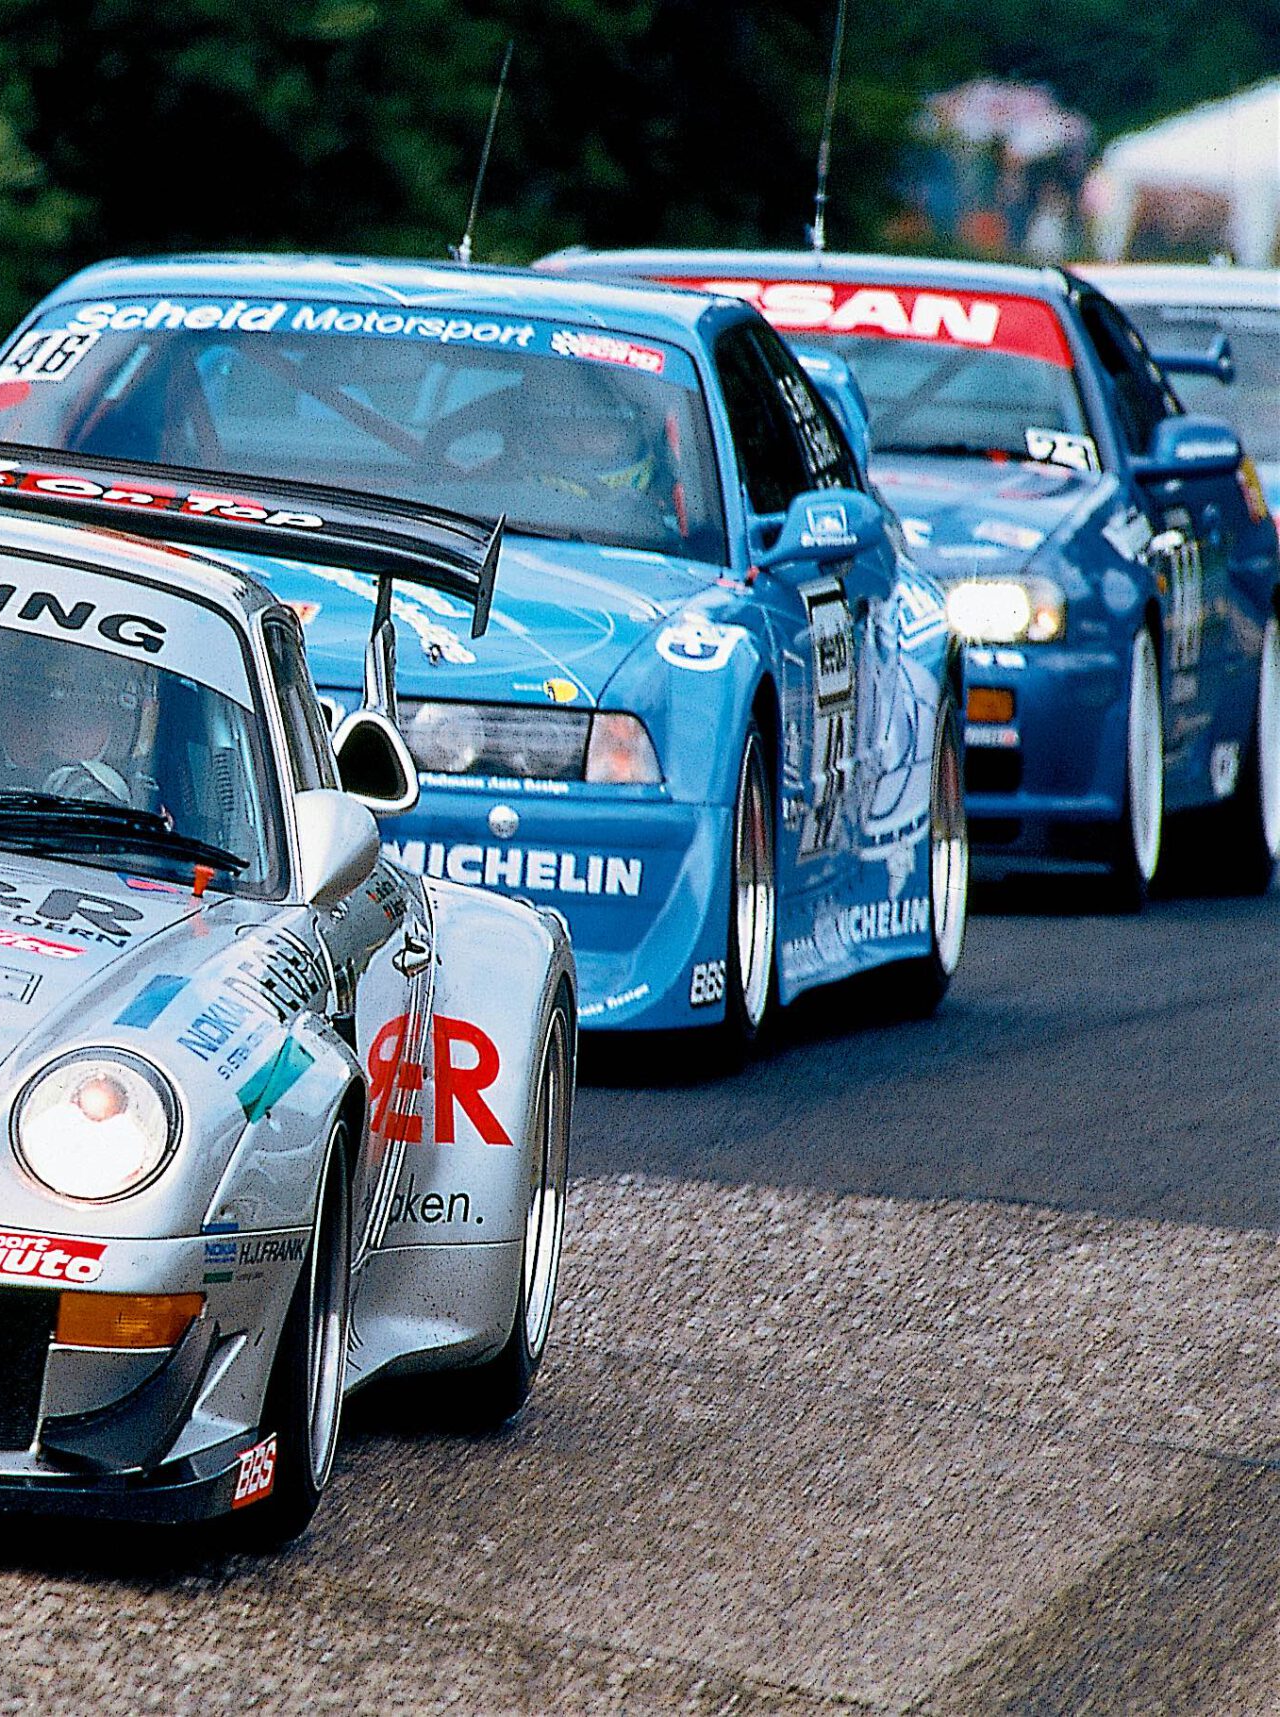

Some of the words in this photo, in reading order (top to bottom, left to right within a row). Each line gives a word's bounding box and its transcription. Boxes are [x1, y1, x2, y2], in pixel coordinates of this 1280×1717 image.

[67, 299, 287, 333] Scheid
[291, 305, 535, 347] Motorsport
[36, 477, 154, 504] On
[186, 493, 323, 529] Top
[380, 838, 642, 897] MICHELIN
[234, 1440, 278, 1500] BBS
